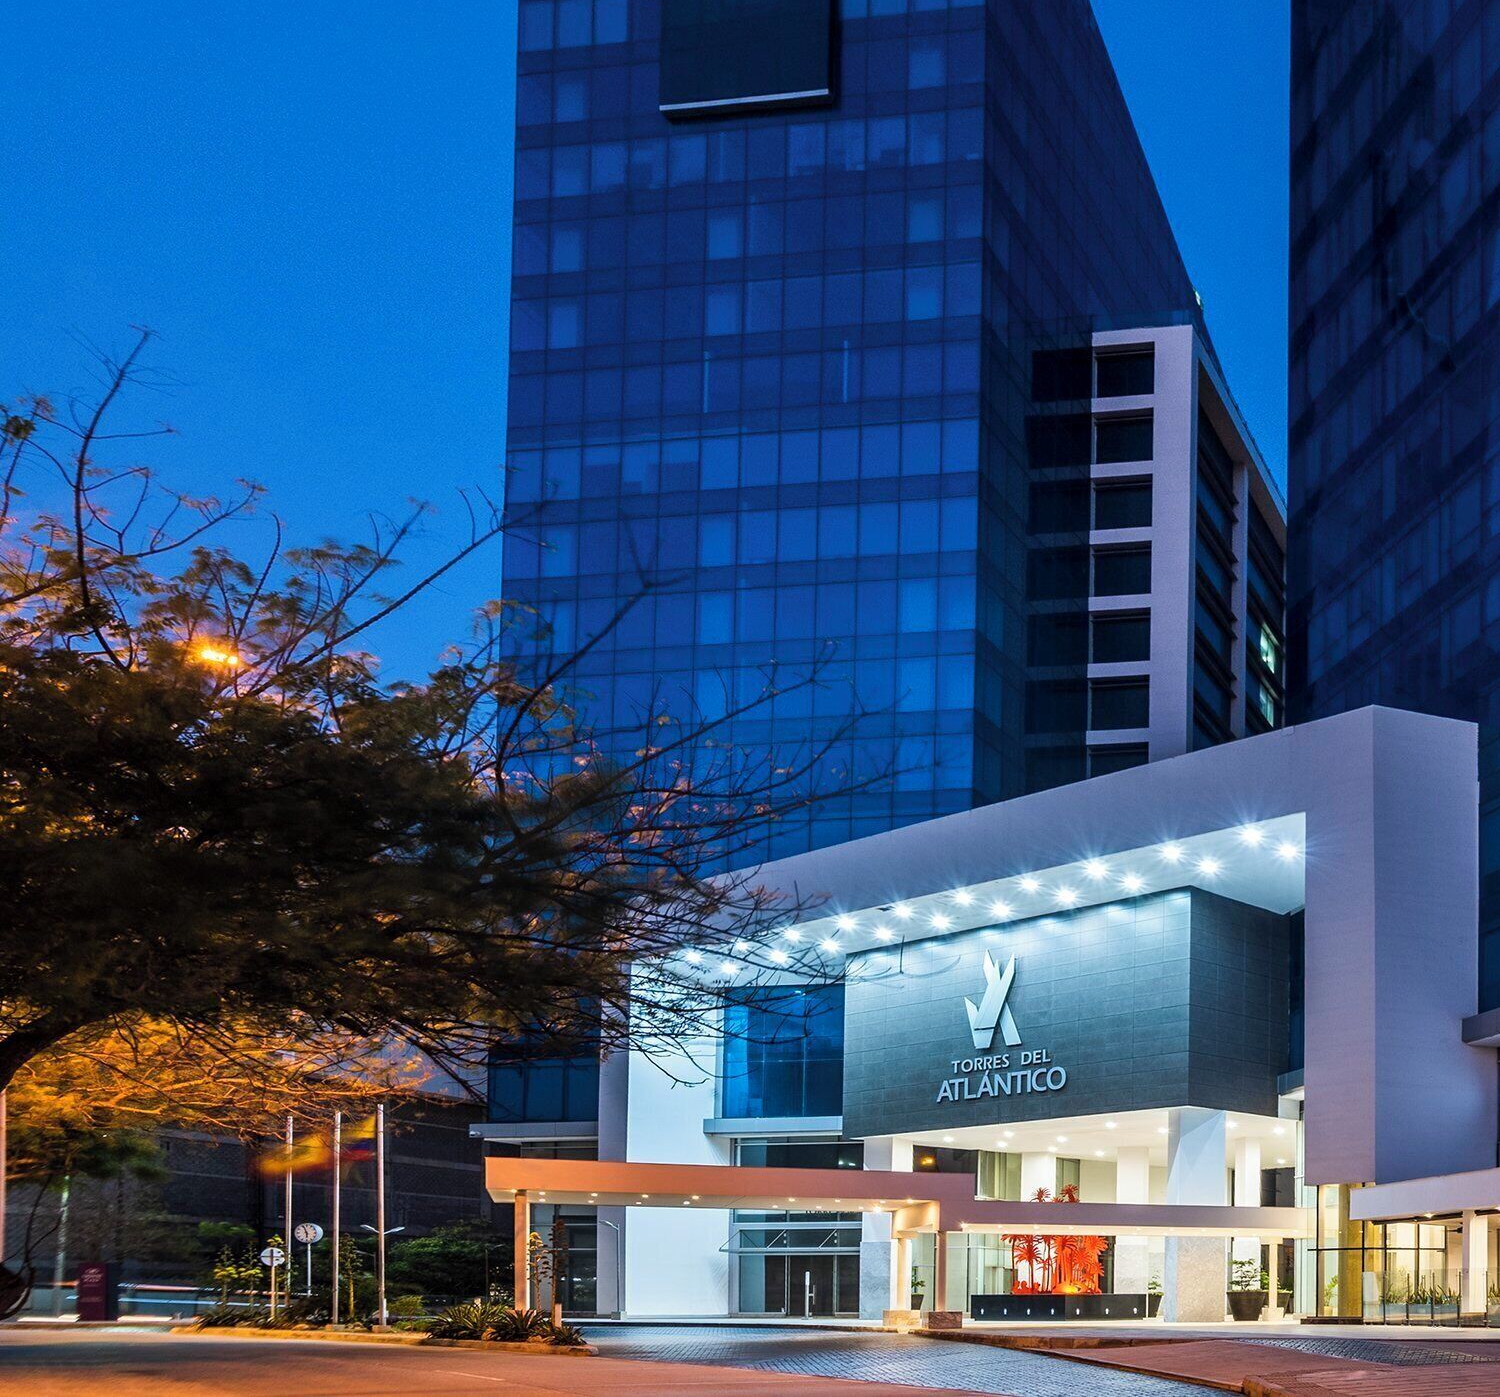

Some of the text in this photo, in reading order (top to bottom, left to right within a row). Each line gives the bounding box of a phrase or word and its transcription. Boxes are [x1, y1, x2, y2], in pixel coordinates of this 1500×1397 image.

[952, 1049, 1051, 1074] TORRES DEL
[936, 1066, 1067, 1103] ATLÁNTICO
